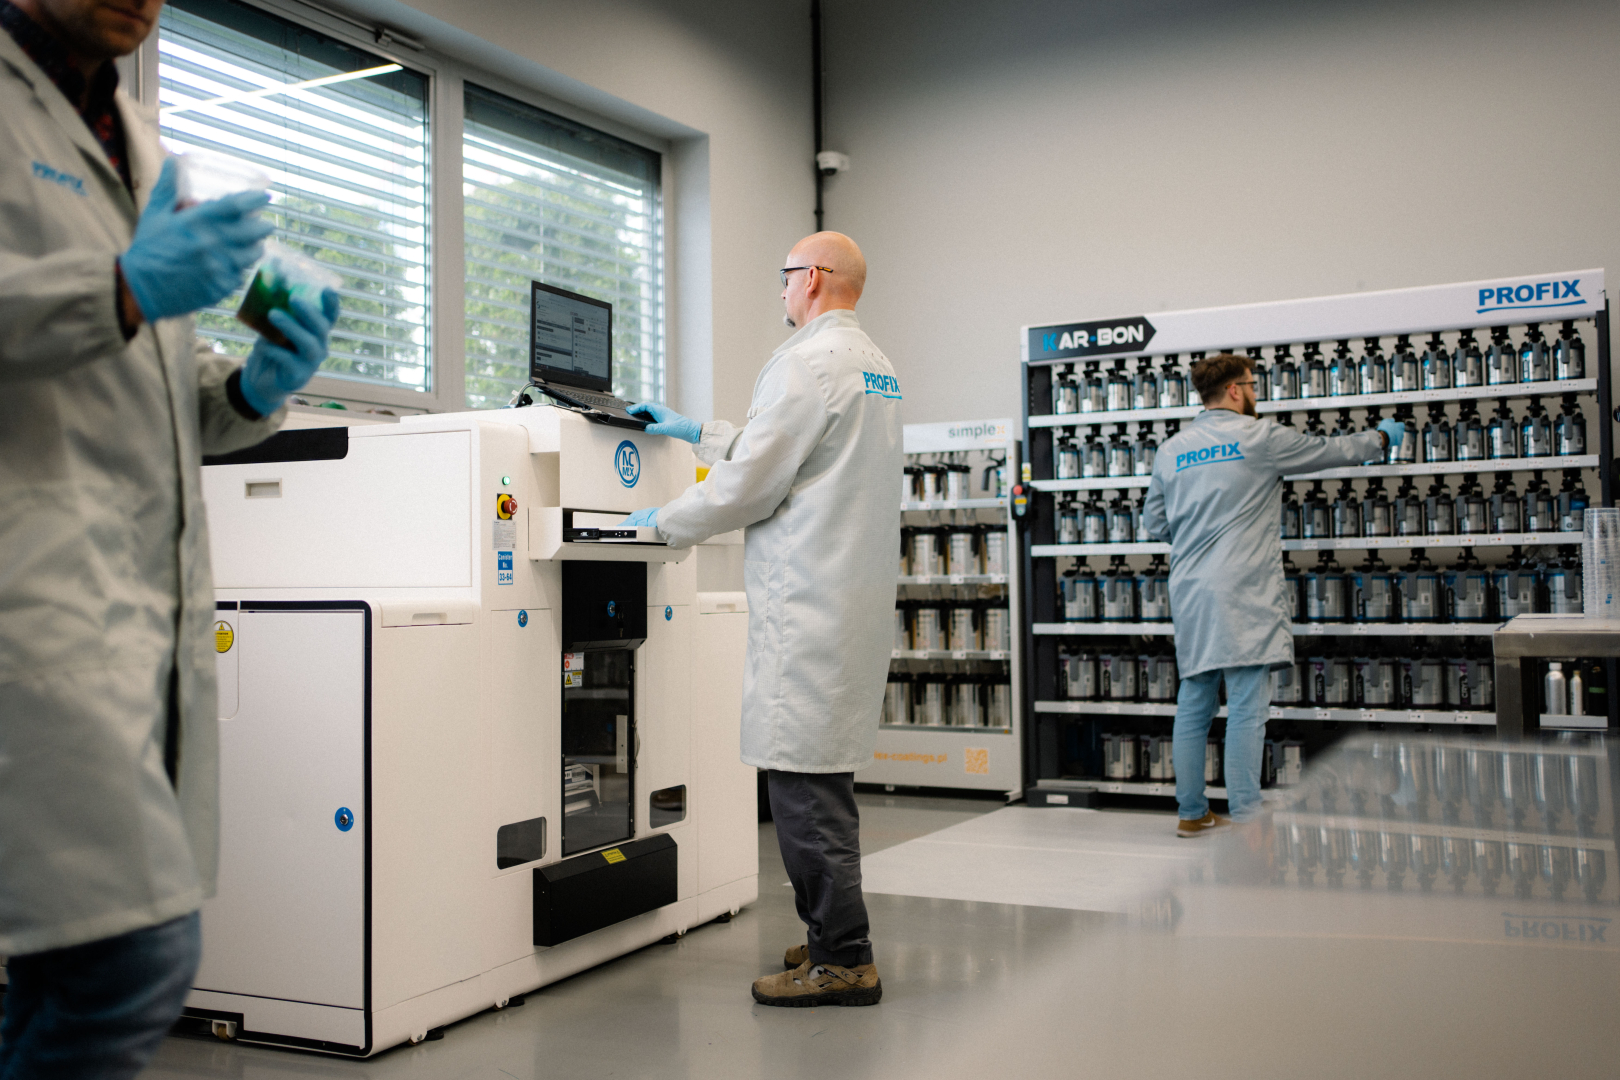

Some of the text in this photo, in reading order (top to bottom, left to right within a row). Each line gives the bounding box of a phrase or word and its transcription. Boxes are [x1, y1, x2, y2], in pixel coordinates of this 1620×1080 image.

[1478, 279, 1581, 306] PROFIX
[862, 371, 901, 394] PROFIX
[948, 423, 1006, 440] simplex
[1176, 441, 1241, 468] PROFIX
[499, 573, 512, 582] 33-64
